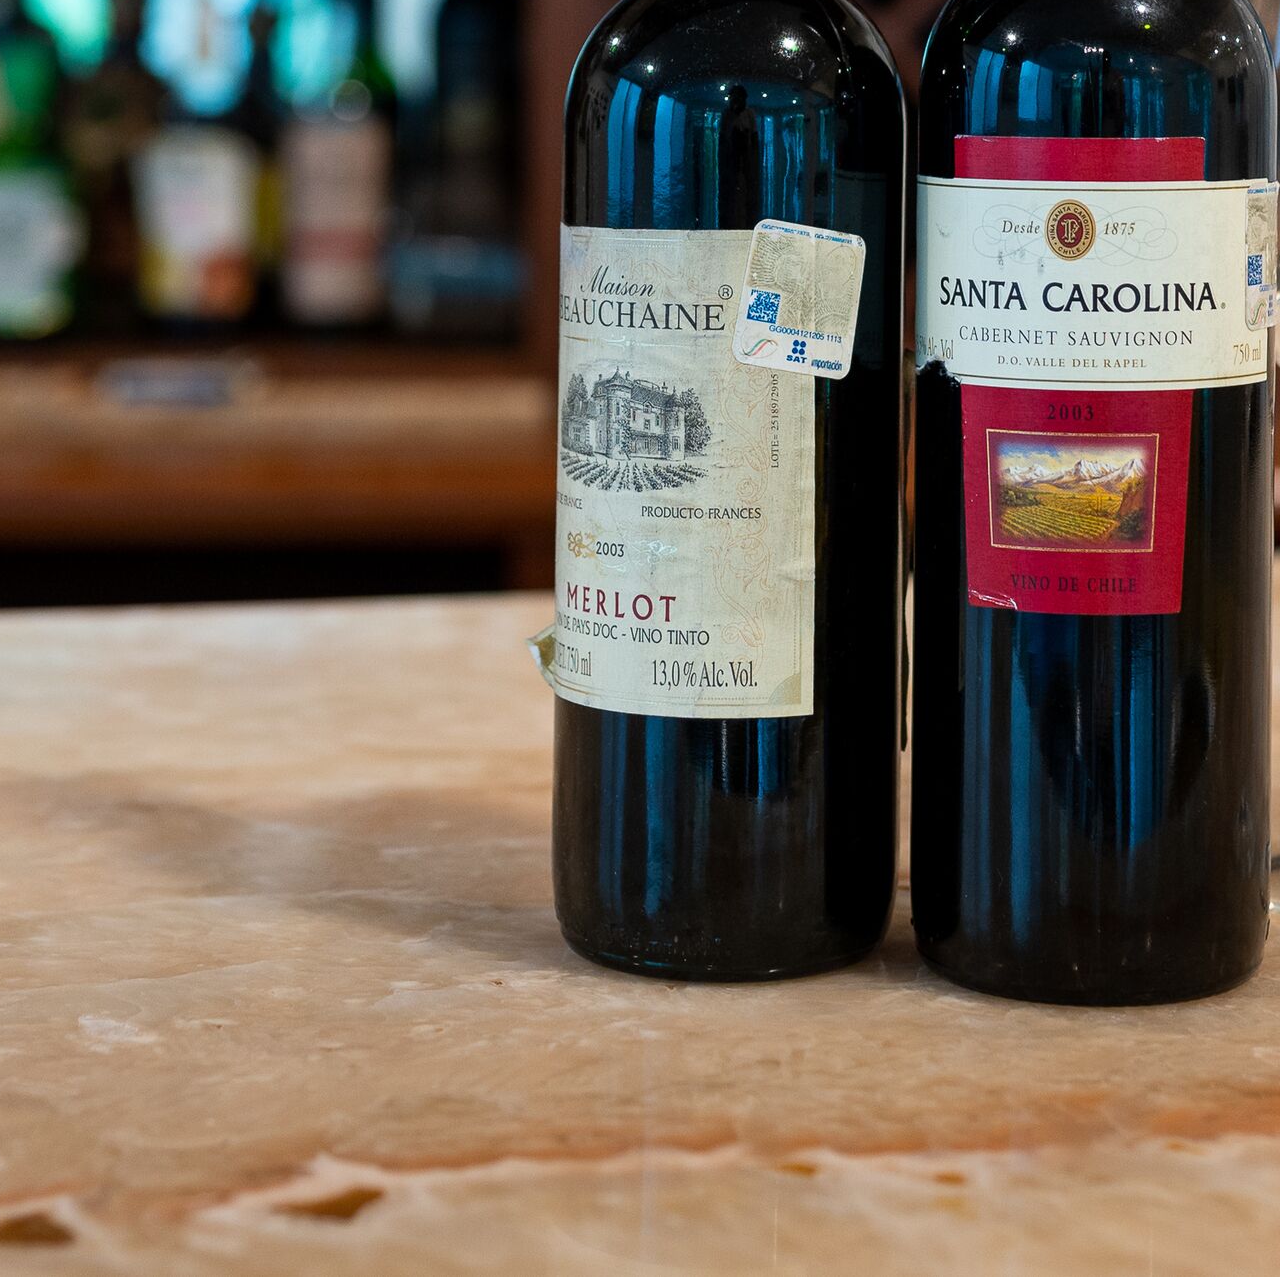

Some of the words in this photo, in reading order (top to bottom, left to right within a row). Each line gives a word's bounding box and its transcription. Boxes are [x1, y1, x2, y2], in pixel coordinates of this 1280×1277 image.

[1002, 219, 1040, 235] Desde
[1052, 206, 1072, 222] SANTA
[1073, 207, 1091, 240] CAROLINA
[1103, 221, 1136, 236] 1875
[1058, 246, 1081, 255] CHILE
[580, 264, 656, 298] Maison
[940, 276, 1027, 311] SANTA
[1041, 281, 1218, 313] CAROLINA
[959, 325, 1058, 346] CABERNET
[1067, 329, 1194, 347] SAUVIGNON
[786, 355, 807, 364] SAT
[997, 355, 1022, 366] D.O.
[1025, 356, 1066, 367] VALLE
[1072, 358, 1098, 368] DEL
[1103, 359, 1148, 369] RAPEL
[1233, 342, 1250, 366] 750
[1252, 339, 1261, 361] ml
[1046, 403, 1095, 421] 2003
[641, 505, 704, 520] PRODUCTO
[708, 507, 762, 521] FRANCES
[595, 541, 625, 558] 2003
[1011, 574, 1051, 591] VINO
[1058, 576, 1079, 592] DE
[1086, 577, 1137, 593] CHILE
[566, 581, 677, 623] MERLOT
[572, 617, 591, 636] PAYS
[593, 622, 618, 640] D'OC
[630, 626, 663, 644] VINO
[667, 629, 711, 646] TINTO
[580, 650, 592, 677] ml
